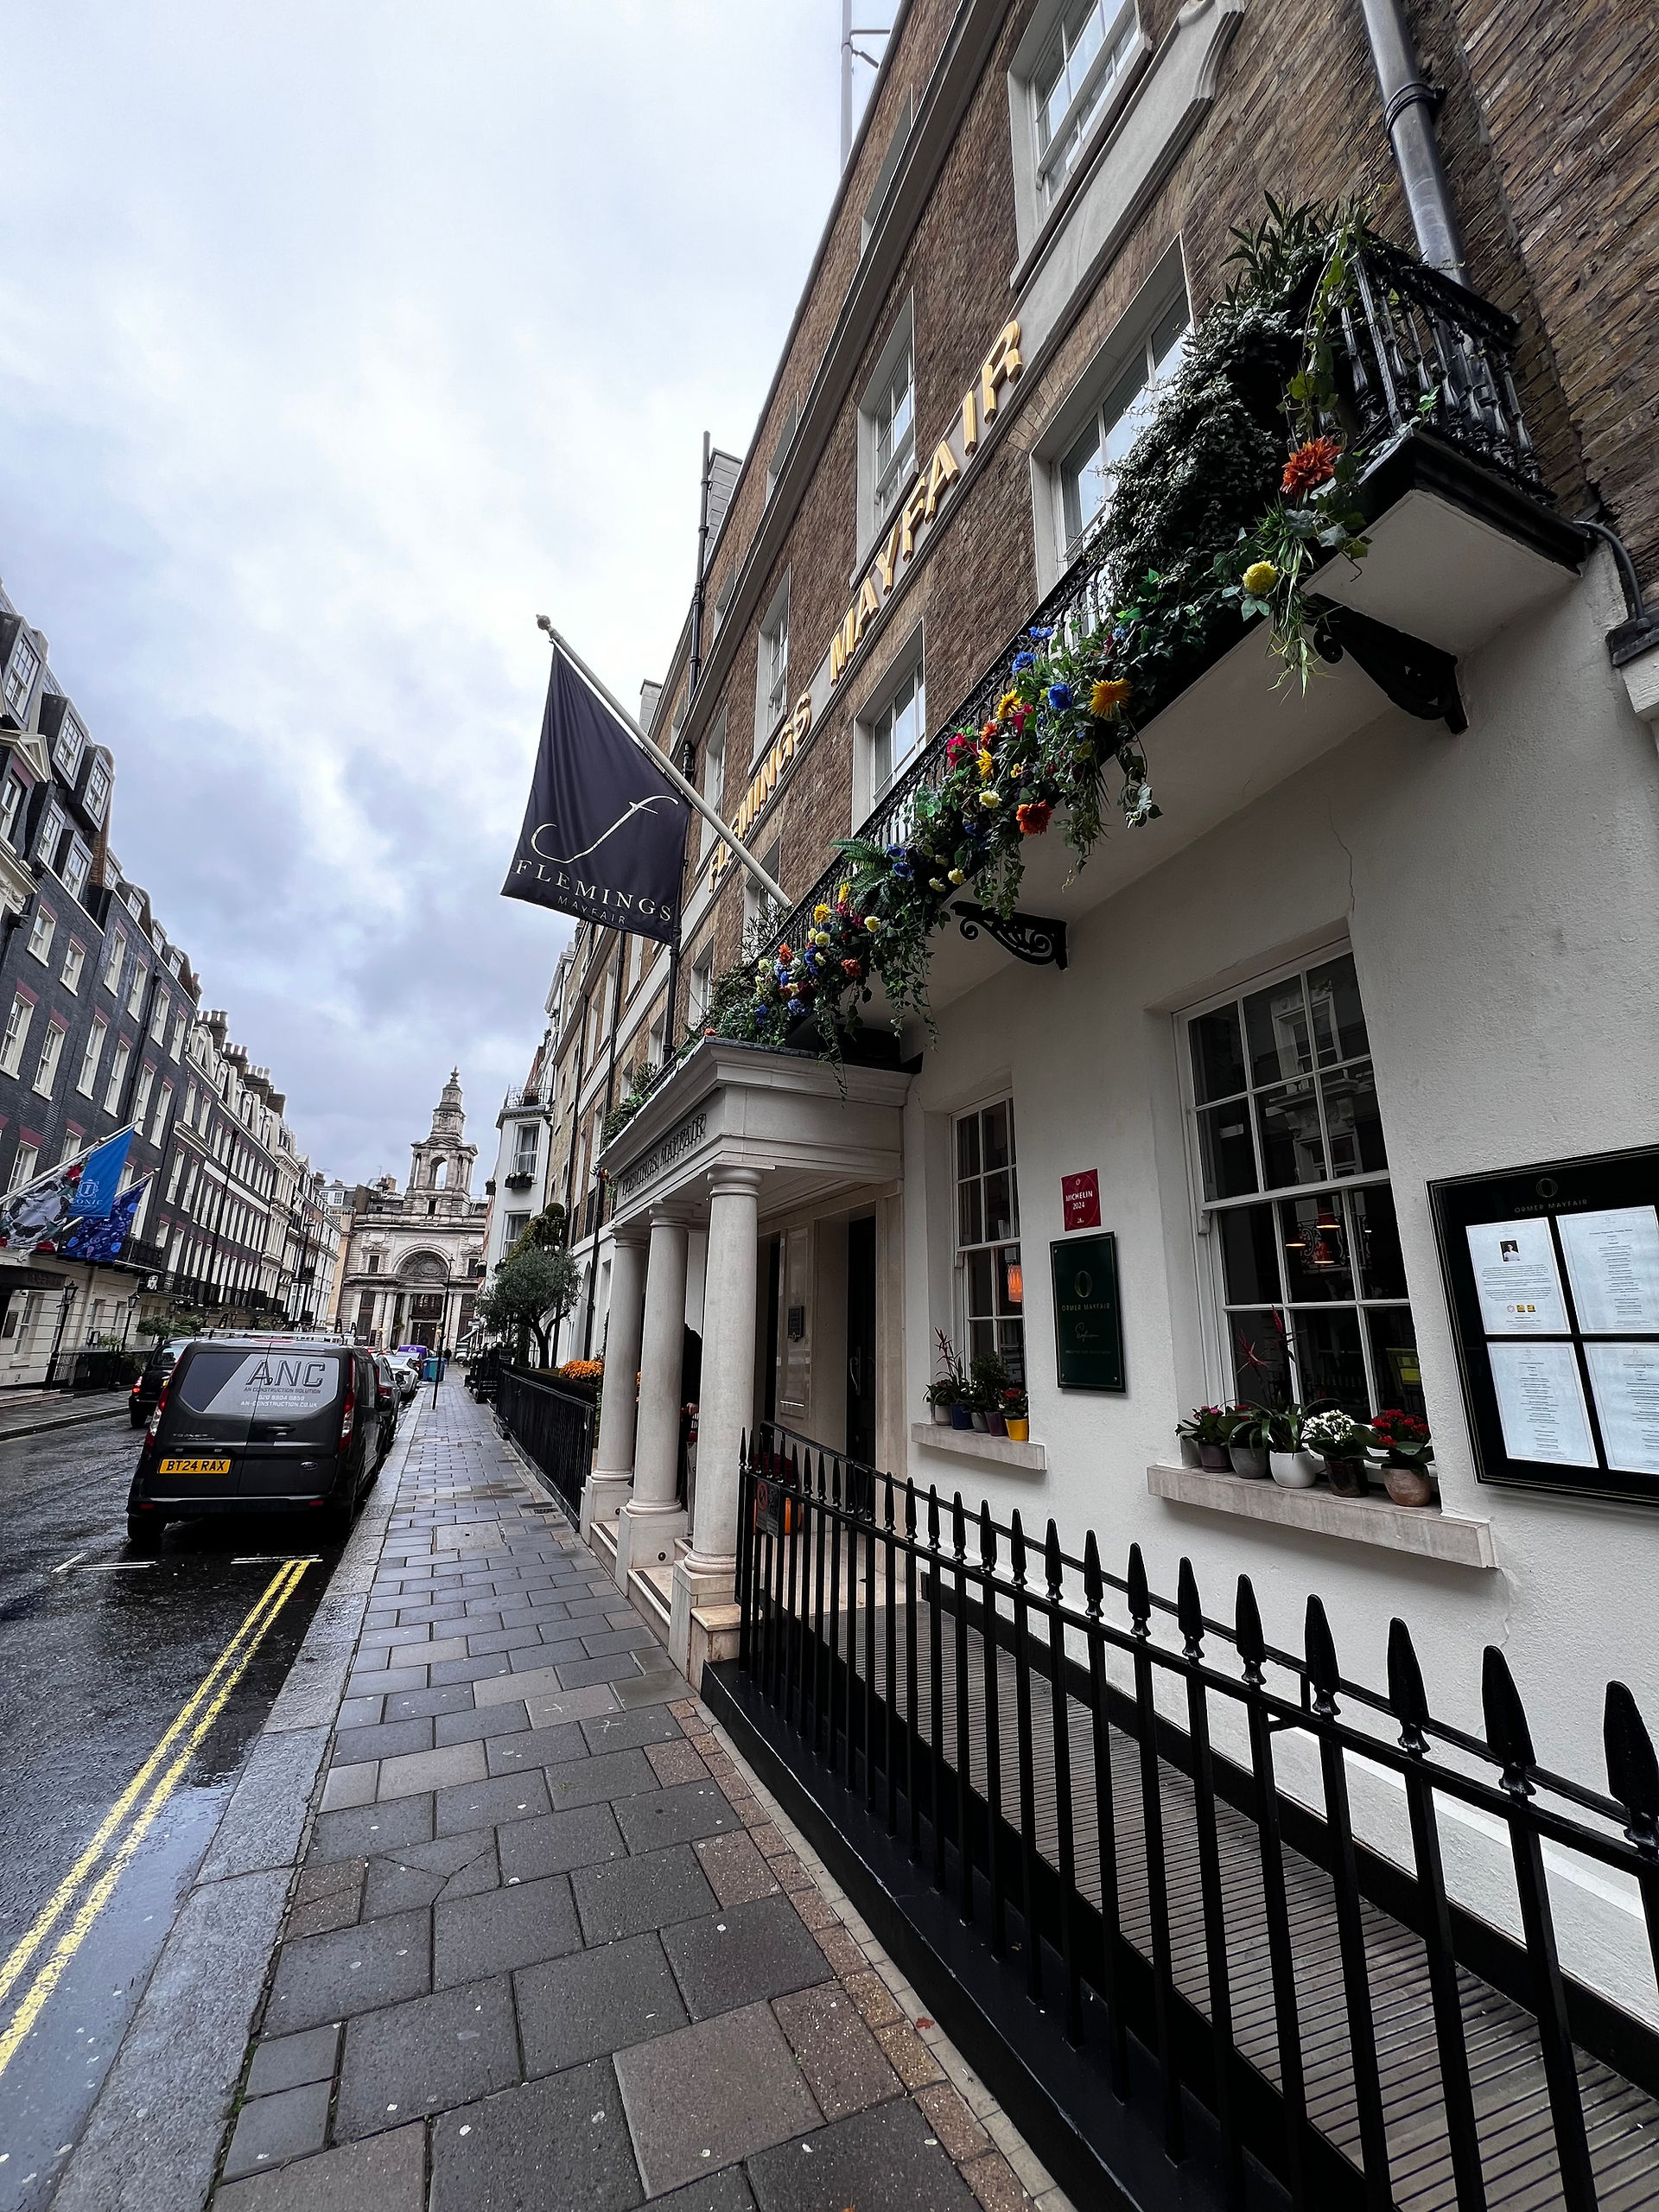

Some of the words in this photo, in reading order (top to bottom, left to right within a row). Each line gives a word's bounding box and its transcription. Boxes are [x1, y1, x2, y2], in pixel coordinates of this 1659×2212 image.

[830, 320, 1023, 688] MAYFAIR
[514, 860, 672, 922] FLEMINGS
[557, 895, 626, 925] MAYFAIR
[1065, 1190, 1093, 1202] MICHELIN
[1072, 1201, 1085, 1211] 2024
[1515, 1204, 1544, 1213] ORMER
[1548, 1198, 1587, 1209] MAYFAIR
[1084, 1302, 1111, 1311] MAYFAIR
[245, 1359, 326, 1388] ANC
[166, 1460, 198, 1471] BT24
[200, 1460, 227, 1471] RAX
